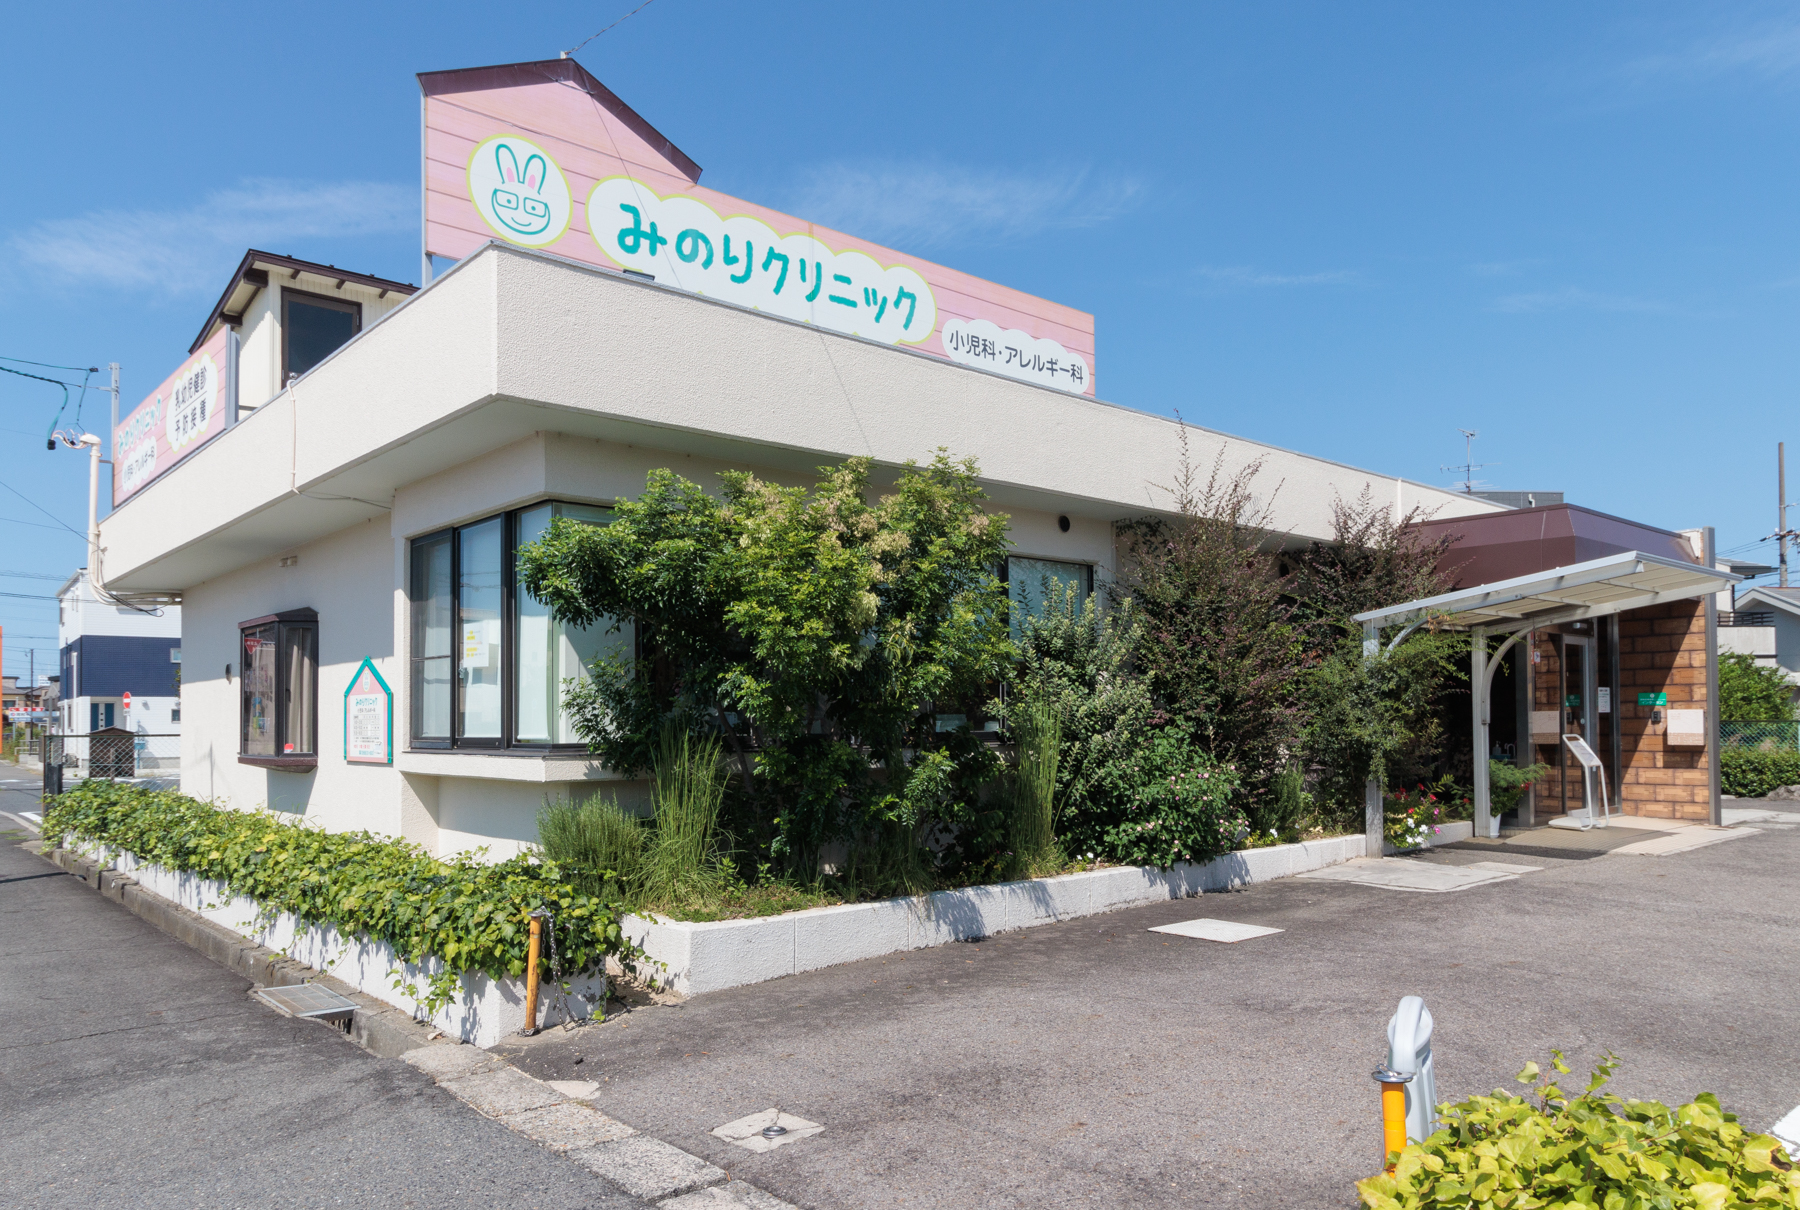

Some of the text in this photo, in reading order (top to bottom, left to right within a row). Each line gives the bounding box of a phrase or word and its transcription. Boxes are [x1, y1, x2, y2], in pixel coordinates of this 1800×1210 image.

[617, 203, 917, 330] みのりクリニック
[949, 329, 1084, 385] 小児科・アレルギー科
[174, 365, 208, 411] 乳幼児健診
[174, 397, 207, 442] 予防接種
